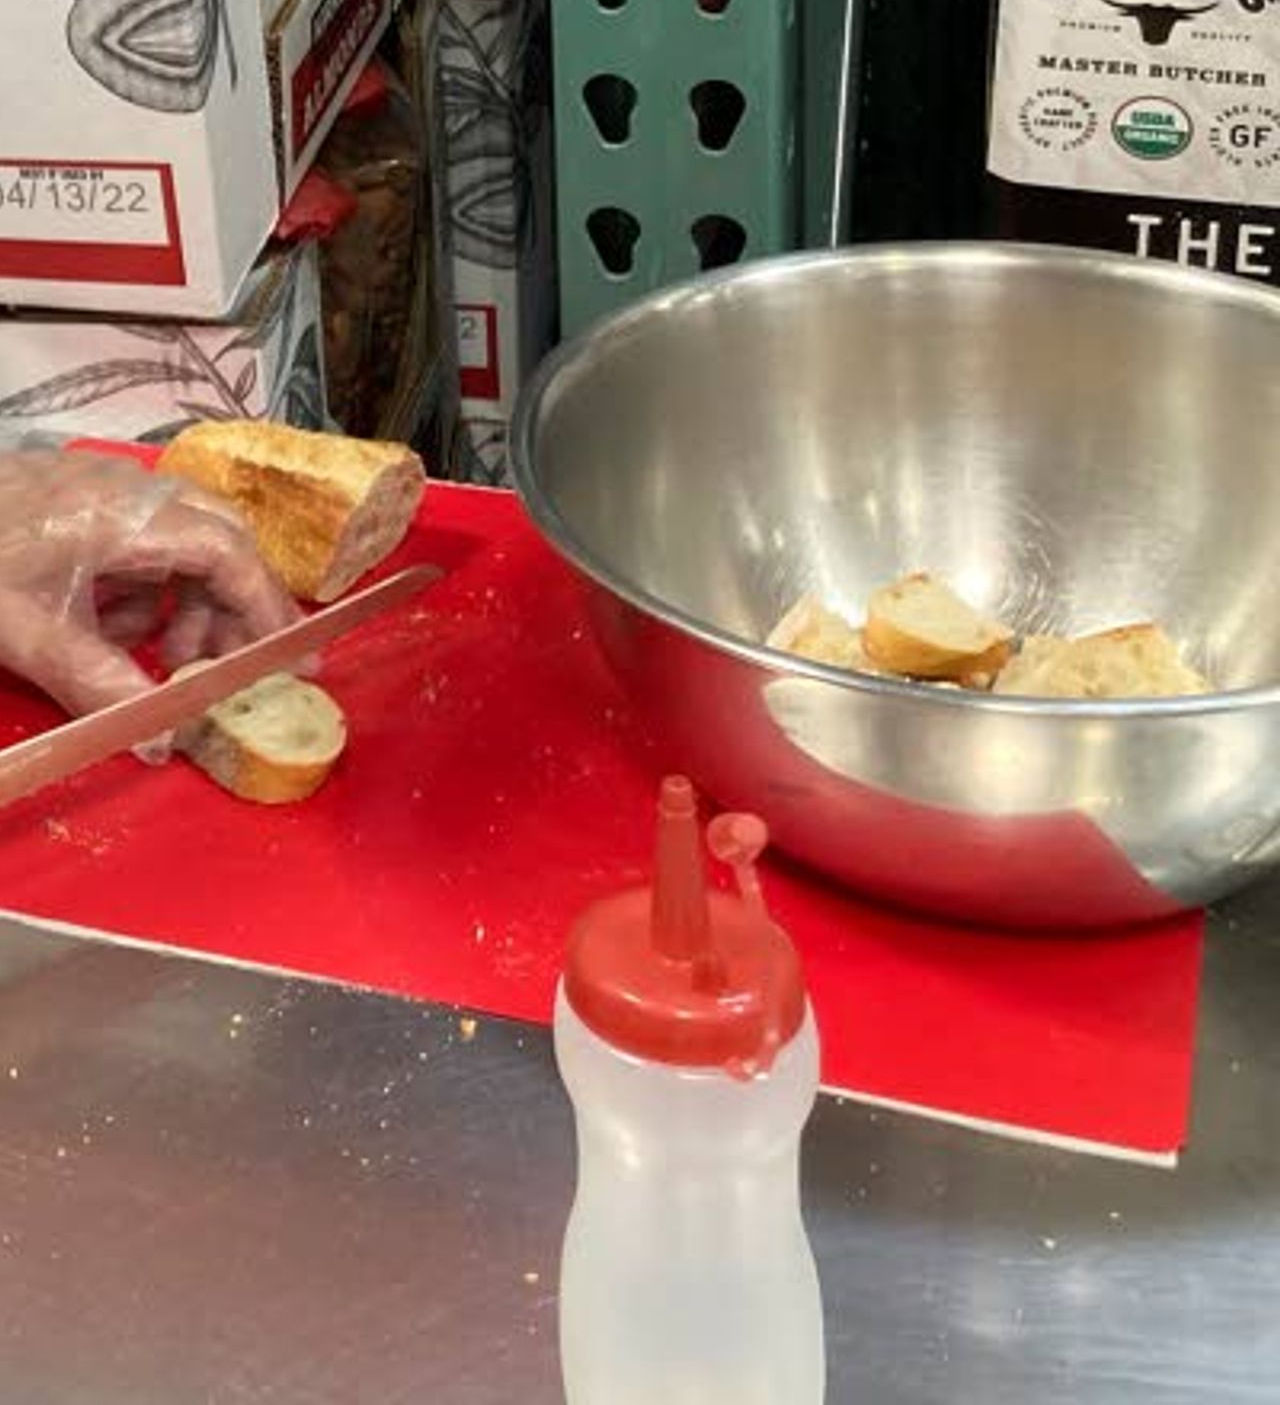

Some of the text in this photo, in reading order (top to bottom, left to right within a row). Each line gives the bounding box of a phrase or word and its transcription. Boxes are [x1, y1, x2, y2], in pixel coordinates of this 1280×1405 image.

[1038, 55, 1267, 88] MASTER BUTCHER
[1130, 110, 1177, 128] USDA
[1229, 124, 1272, 149] GF
[1126, 212, 1276, 275] THE
